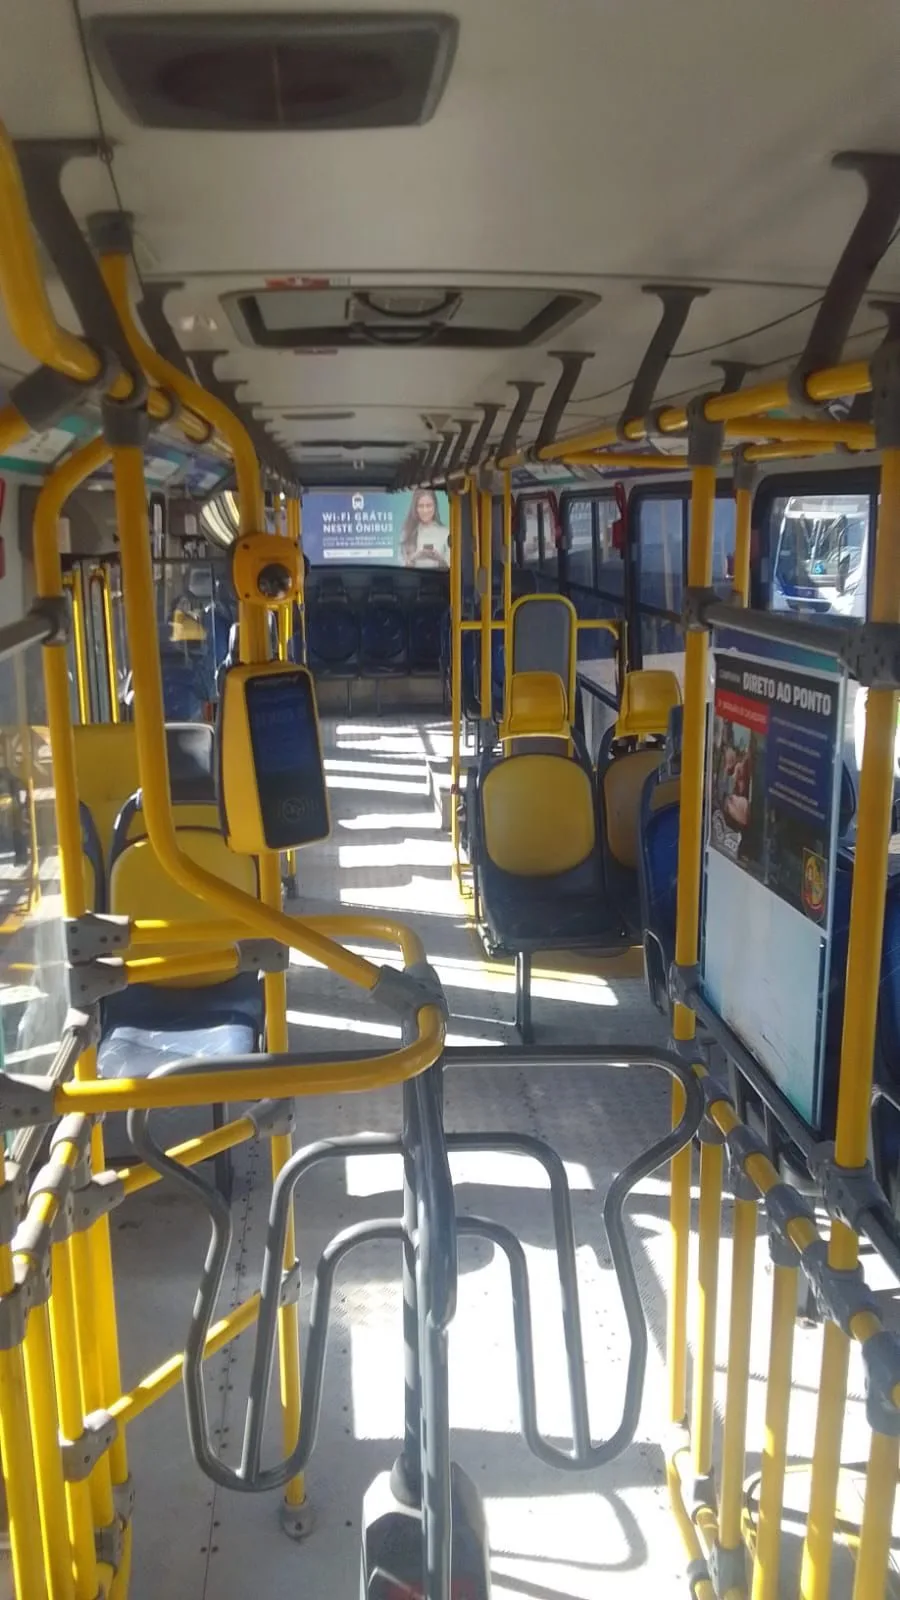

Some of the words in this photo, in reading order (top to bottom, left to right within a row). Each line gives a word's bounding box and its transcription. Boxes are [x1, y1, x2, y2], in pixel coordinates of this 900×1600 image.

[354, 510, 393, 521] GRÁTIS
[323, 523, 353, 533] NESTE
[355, 521, 393, 533] ÔNIBUS
[743, 671, 775, 699] DIRETO
[776, 681, 792, 704] AO
[793, 686, 831, 716] PONTO
